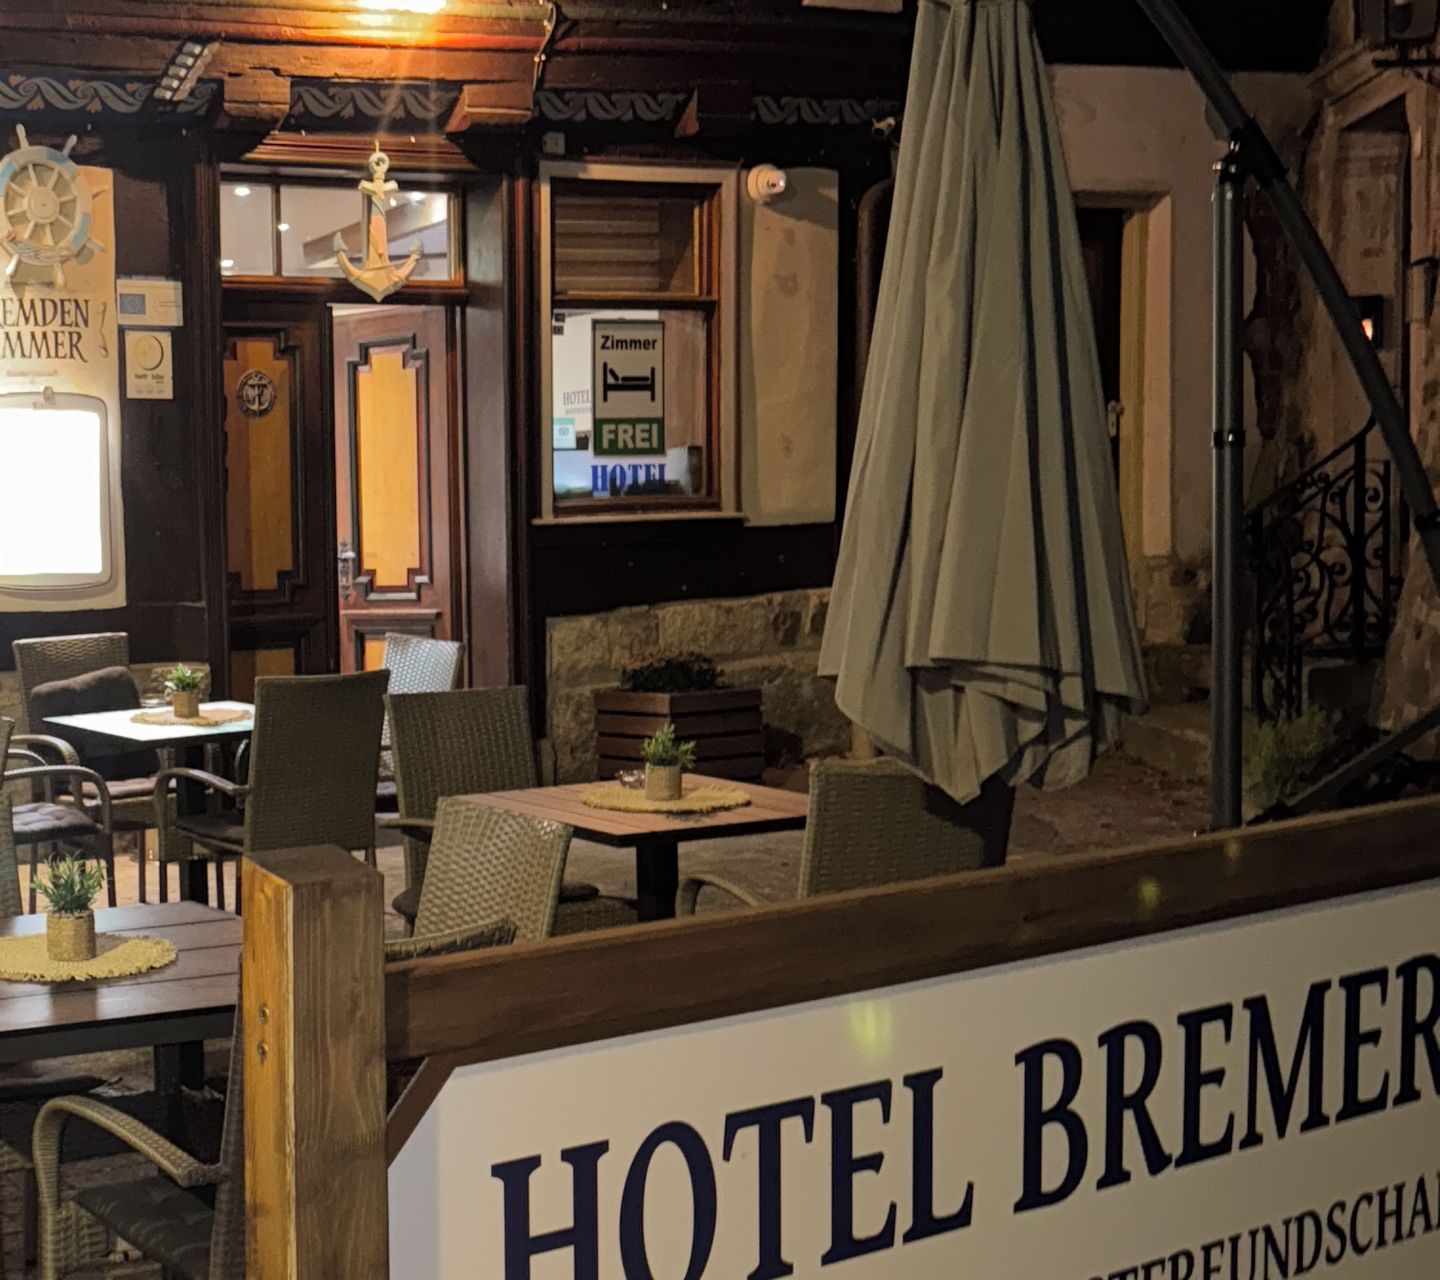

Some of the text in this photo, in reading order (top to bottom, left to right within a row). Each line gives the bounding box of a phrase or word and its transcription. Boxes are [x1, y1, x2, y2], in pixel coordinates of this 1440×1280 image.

[600, 334, 657, 351] Zimmer
[602, 423, 658, 449] FREI
[1014, 953, 1440, 1214] BREMER
